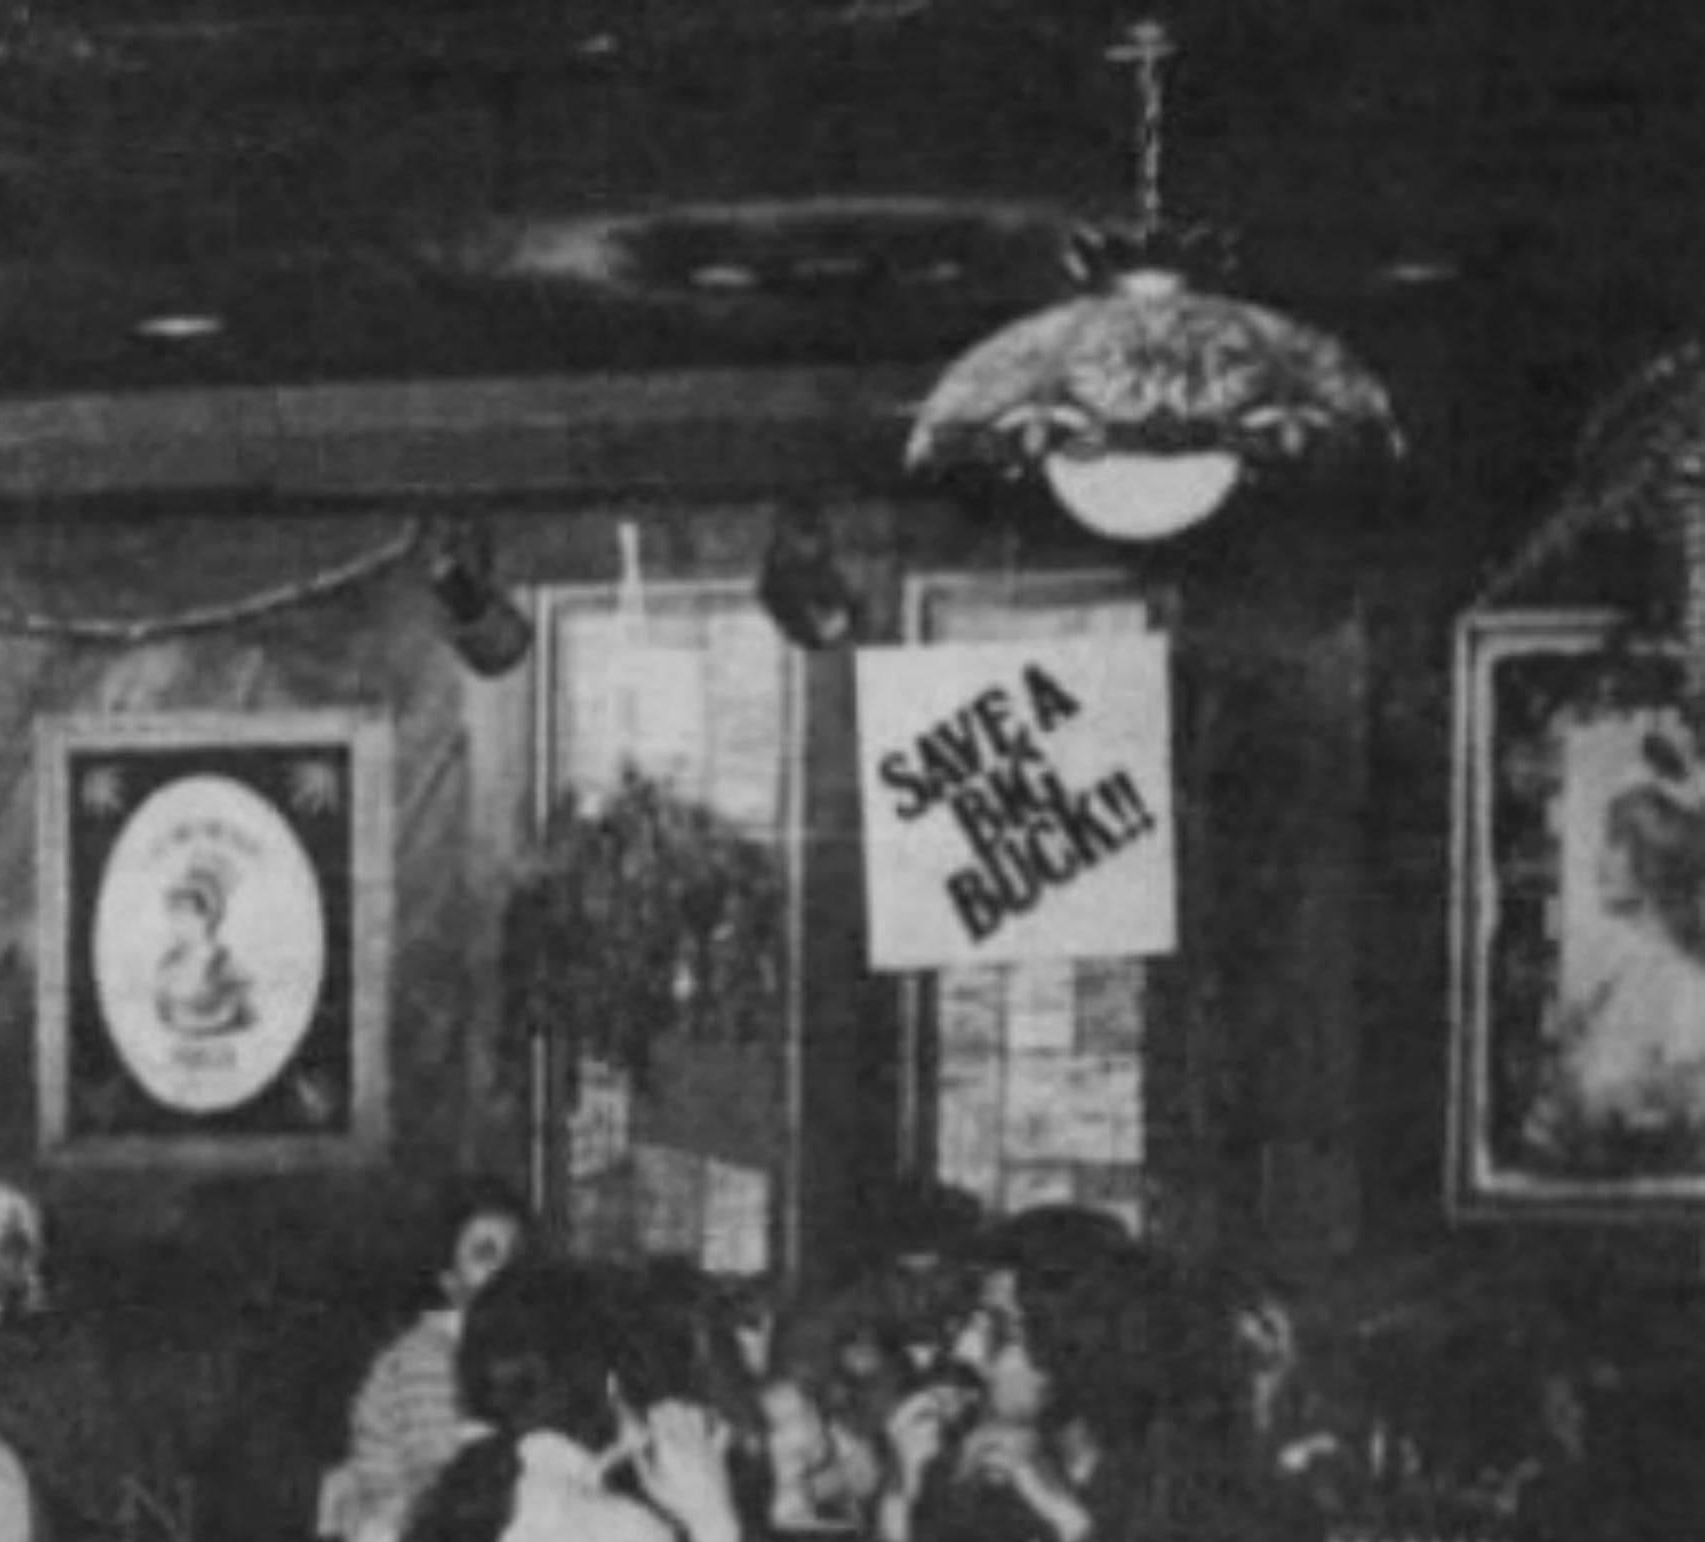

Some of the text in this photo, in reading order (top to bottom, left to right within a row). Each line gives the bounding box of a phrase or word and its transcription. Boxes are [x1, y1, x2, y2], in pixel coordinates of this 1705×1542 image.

[877, 663, 1081, 822] SAVE A
[945, 768, 1157, 948] BUCK!!
